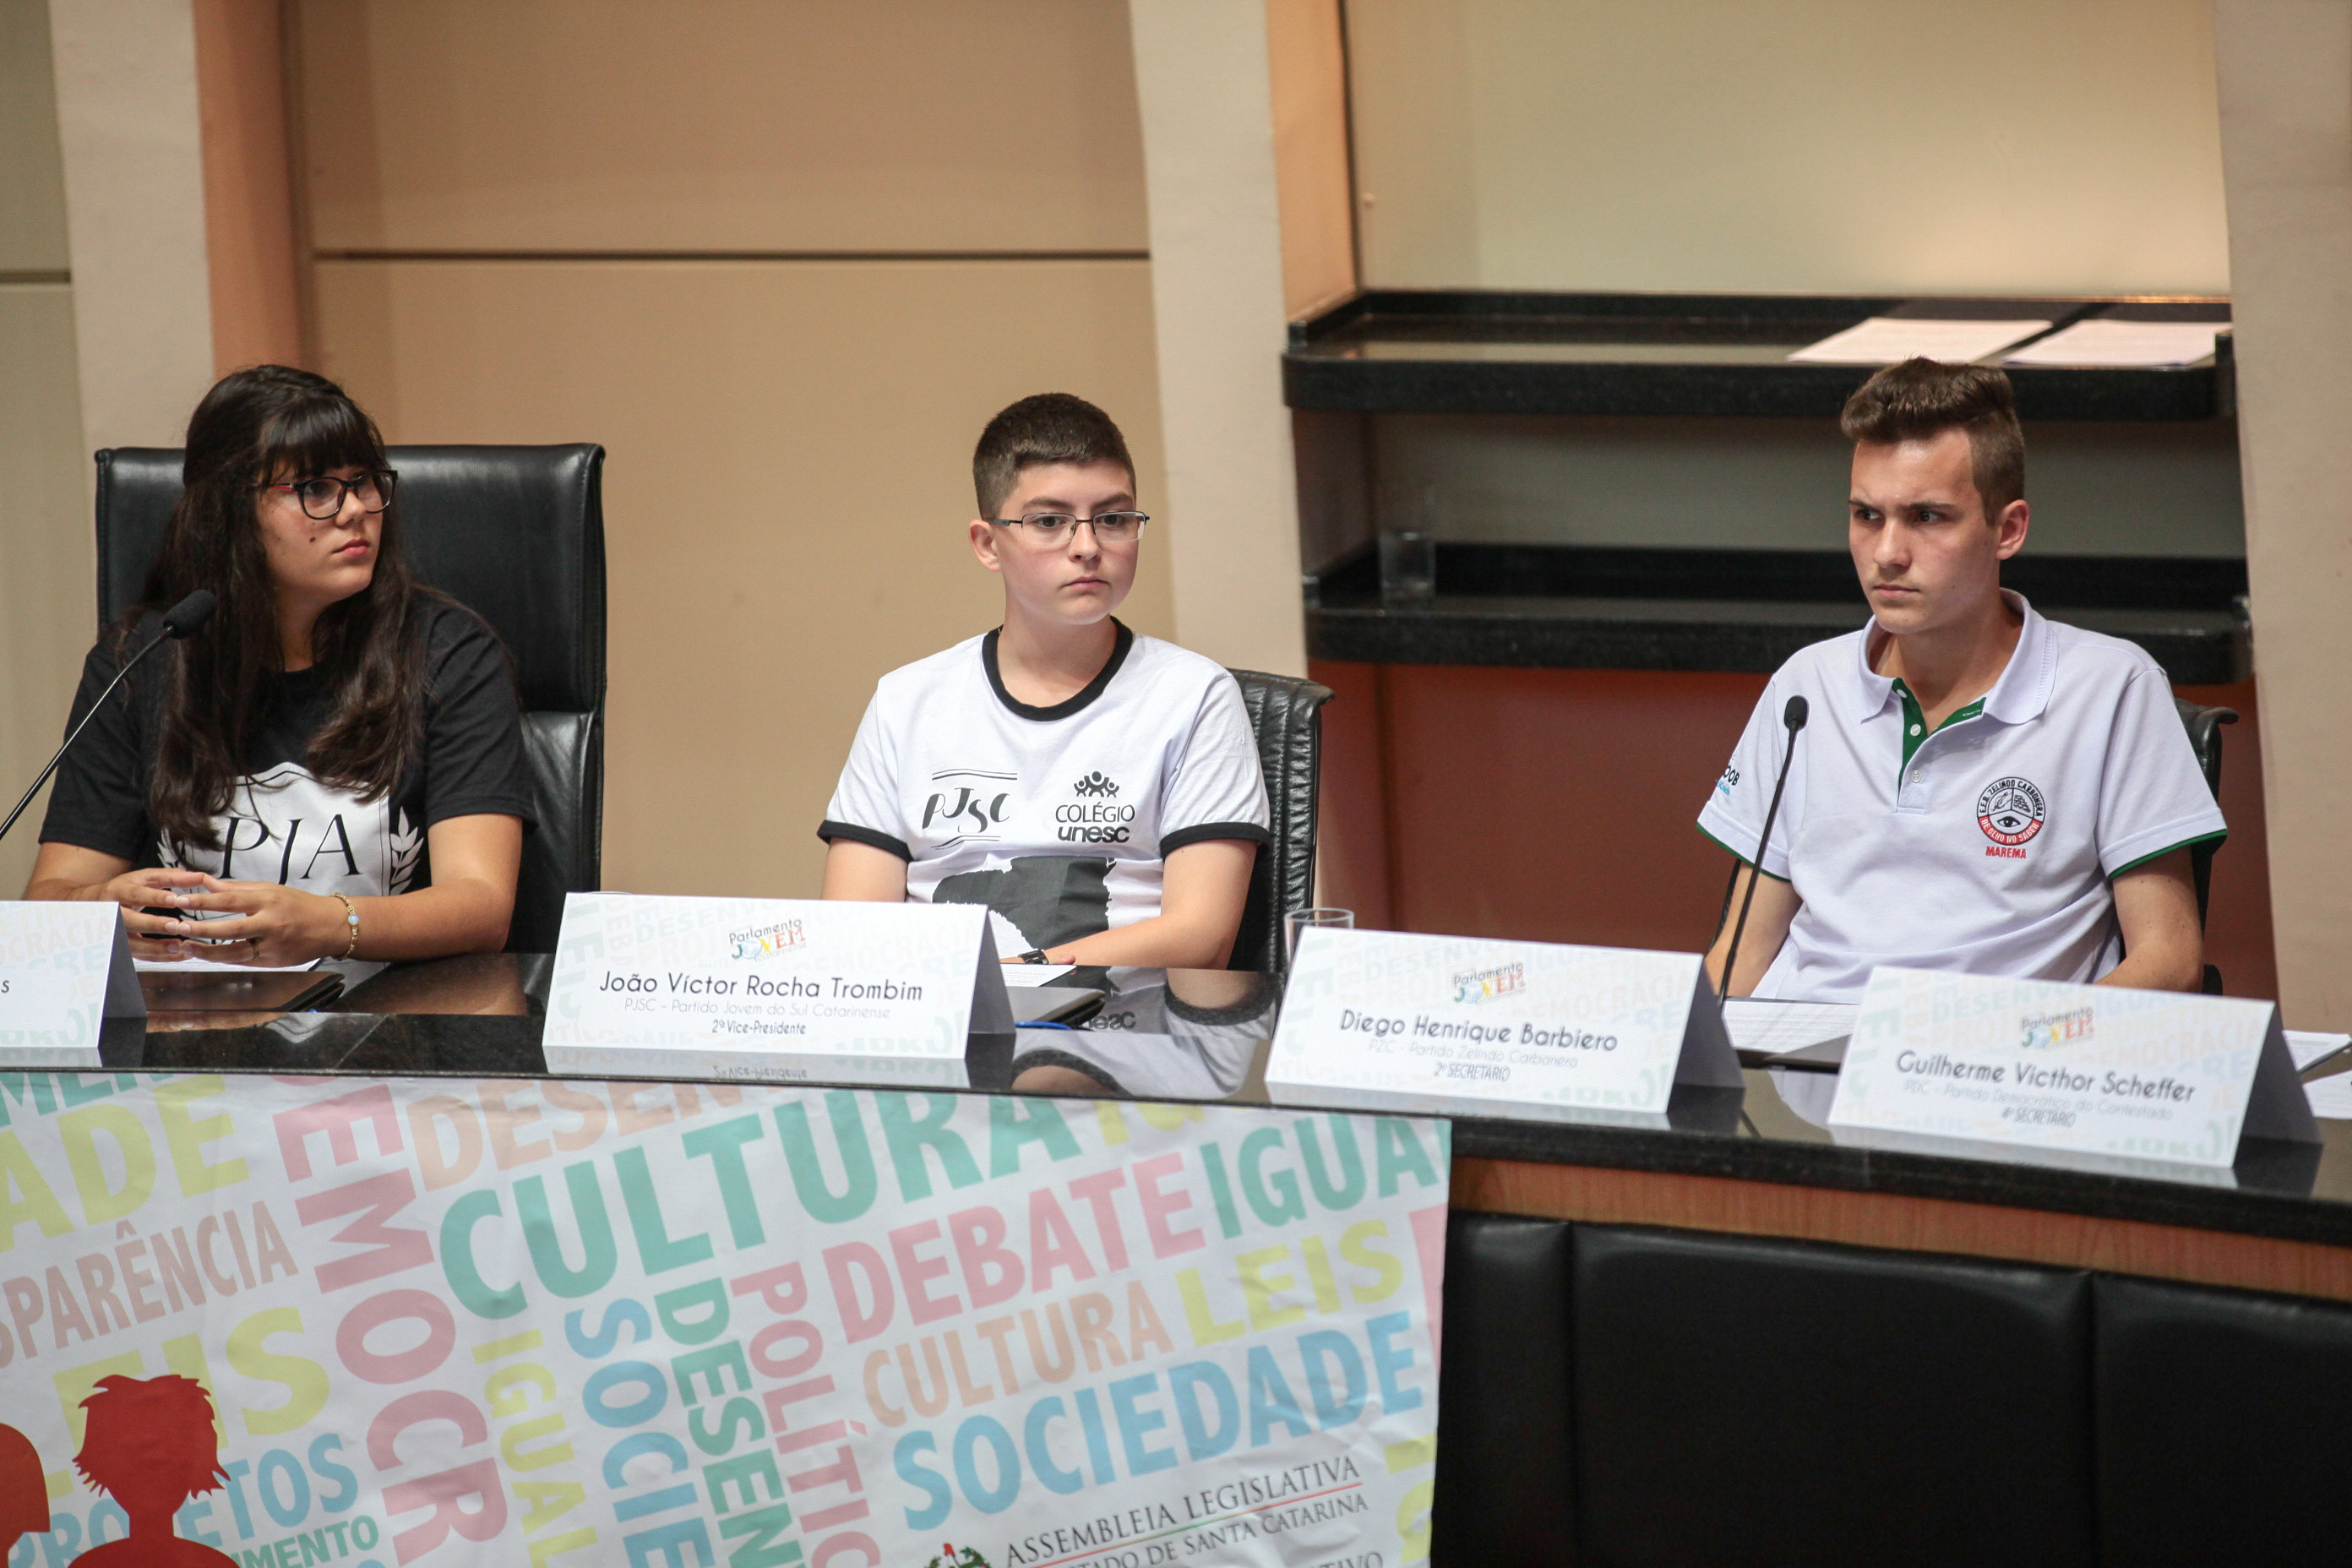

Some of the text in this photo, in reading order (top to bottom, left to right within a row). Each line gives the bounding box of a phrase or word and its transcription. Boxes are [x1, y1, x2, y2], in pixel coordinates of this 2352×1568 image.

[1055, 802, 1135, 823] COLÉGIO
[2017, 781, 2044, 816] CARBONERA
[217, 814, 364, 885] PJA
[1058, 825, 1130, 843] unesc
[1985, 846, 2027, 859] MAREMA
[1988, 829, 2004, 842] OLHO
[2006, 835, 2017, 843] NO
[2018, 823, 2039, 841] SABER
[728, 918, 802, 945] Parlamento
[600, 971, 923, 1000] João Víctor Rocha Trombim
[1453, 961, 1524, 986] Parlamento
[624, 998, 656, 1011] PJSC
[672, 999, 717, 1013] Partido
[725, 1002, 762, 1015] Jovem
[767, 1003, 785, 1015] do
[790, 1004, 808, 1015] Sul
[813, 1004, 890, 1019] Catarinense
[727, 1020, 806, 1035] Vice-Presidente
[1340, 1009, 1618, 1052] Diego Henrique Barbiero
[1408, 1042, 1454, 1057] Partido
[1457, 1044, 1505, 1062] Zelindo
[1508, 1048, 1578, 1069] Carbonera
[1896, 1049, 2197, 1102] Guilherme Victhor Scheffer
[1200, 1113, 1452, 1239] IGUA
[439, 1091, 1082, 1320] CULTURA
[821, 1152, 1206, 1344] DEBATE
[1174, 1220, 1404, 1348] LEIS
[270, 1075, 507, 1566] EMOCR
[863, 1281, 1174, 1428] CULTURA
[893, 1310, 1424, 1531] SOCIEDADE
[1006, 1504, 1178, 1568] ASSEMBLEIA
[1183, 1456, 1361, 1519] LEGISLATIVA
[1146, 1541, 1179, 1565] DE
[1184, 1520, 1257, 1556] SANTA
[1261, 1492, 1370, 1535] CATARINA
